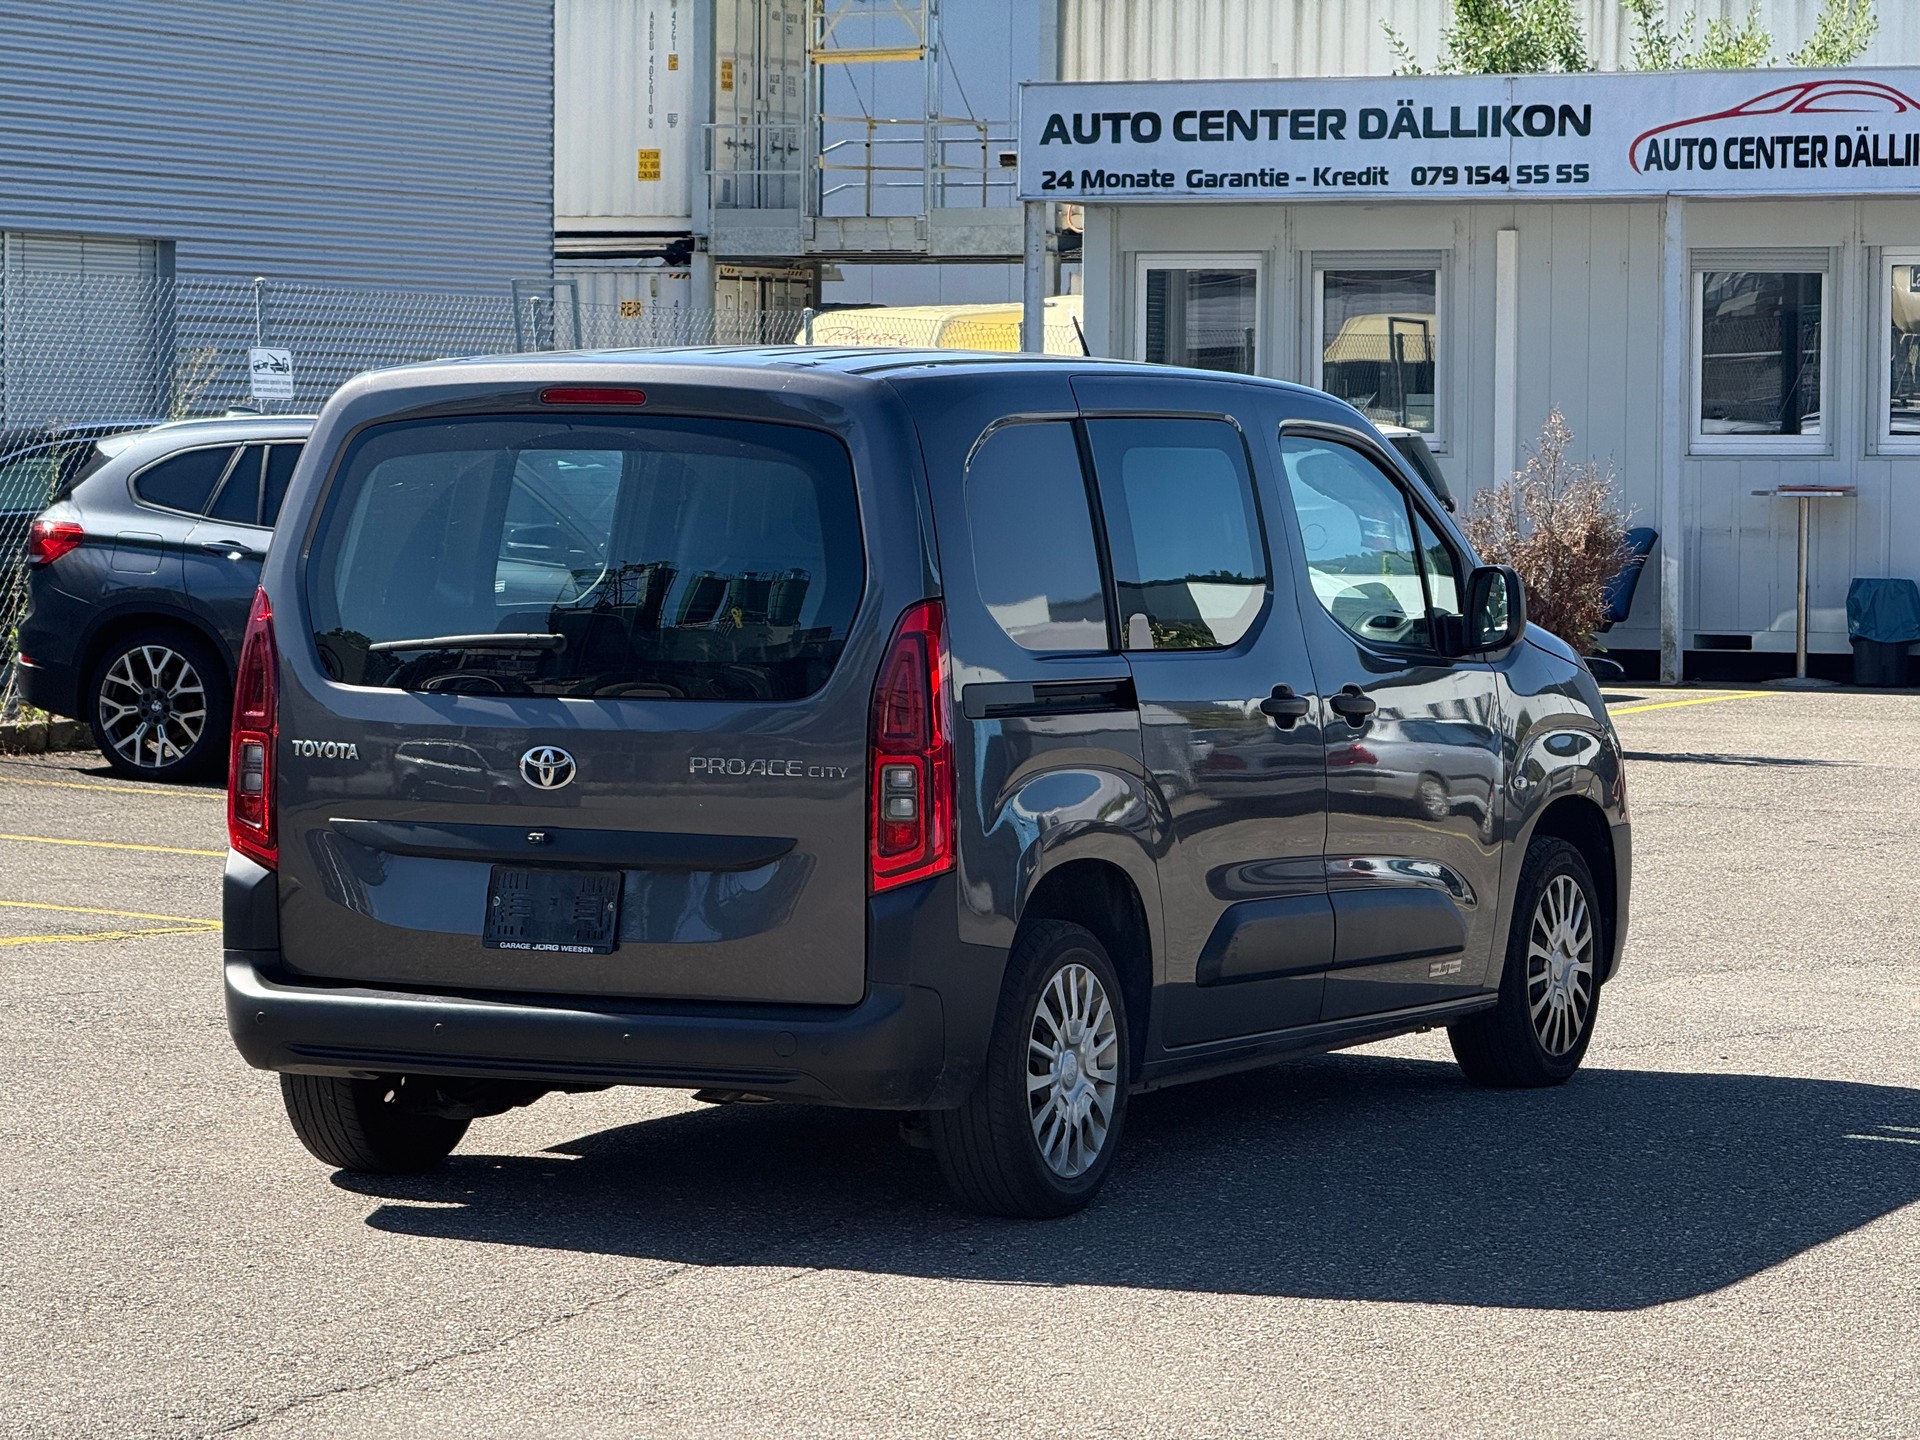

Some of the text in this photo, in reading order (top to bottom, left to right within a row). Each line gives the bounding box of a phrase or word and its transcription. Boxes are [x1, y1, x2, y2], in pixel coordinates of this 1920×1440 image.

[1040, 99, 1592, 145] AUTO CENTER DÄLLIKON
[1643, 137, 1718, 171] AUTO
[1723, 135, 1828, 170] CENTER
[1041, 170, 1074, 190] 24
[1081, 169, 1175, 189] Monate
[1186, 168, 1290, 188] Garantie
[1313, 166, 1389, 187] Kredit
[1411, 166, 1458, 186] 079
[1464, 165, 1509, 185] 154
[1516, 164, 1549, 184] 55
[1556, 164, 1589, 184] 55
[621, 302, 641, 316] REAR
[291, 739, 359, 760] TOYOTA
[689, 756, 849, 778] PROACE CITY
[499, 942, 531, 950] GARAGE
[560, 945, 594, 953] WEESEN
